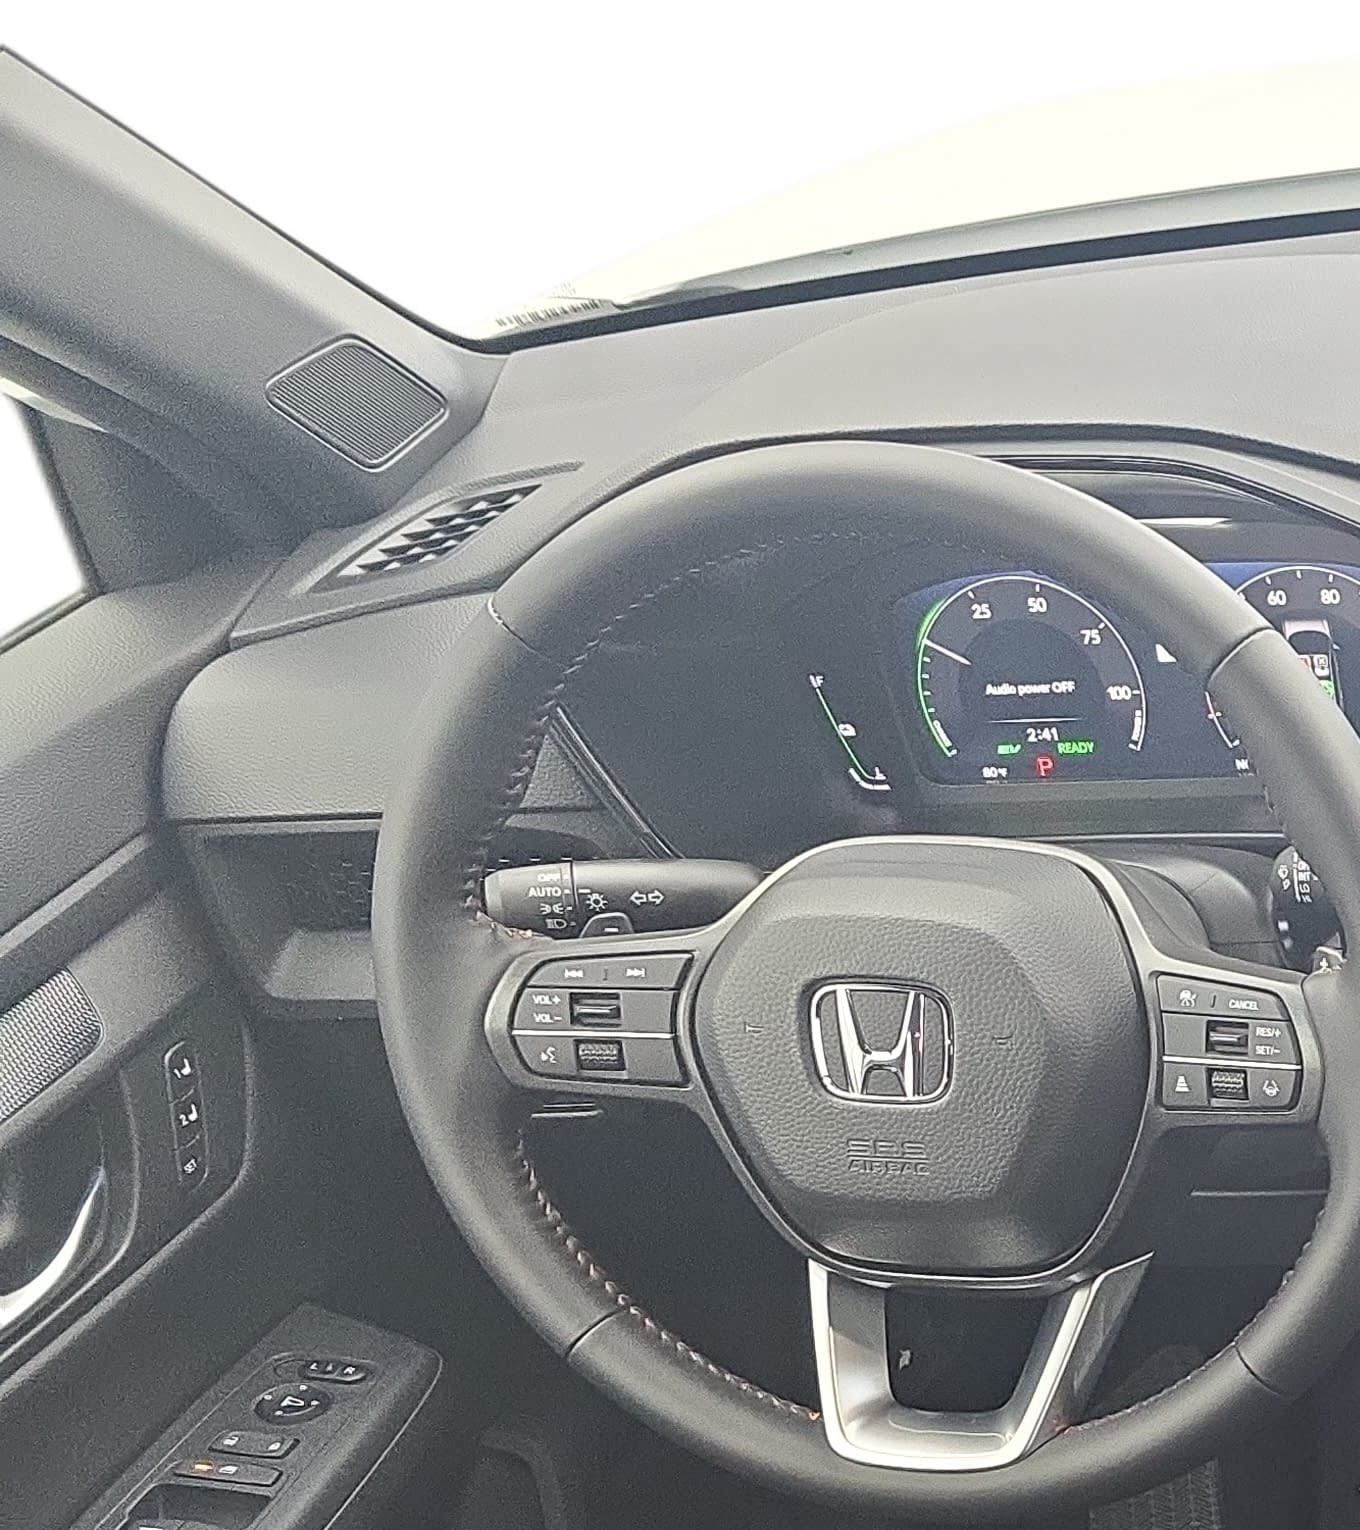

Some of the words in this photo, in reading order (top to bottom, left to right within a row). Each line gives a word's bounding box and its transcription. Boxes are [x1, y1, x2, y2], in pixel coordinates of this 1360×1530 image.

[1267, 590, 1287, 606] 60
[1320, 589, 1341, 605] 80
[970, 603, 992, 620] 25
[1026, 597, 1047, 614] 50
[1080, 629, 1102, 646] 75
[985, 683, 1017, 696] Audio
[1018, 683, 1050, 696] power
[1052, 681, 1076, 693] OFF
[1106, 686, 1132, 701] 100
[1026, 728, 1059, 743] 2:41
[1057, 742, 1094, 754] READY
[1037, 757, 1054, 776] P
[528, 887, 562, 897] AUTO
[1229, 998, 1259, 1011] CANCEL
[1256, 1026, 1281, 1038] RES/+
